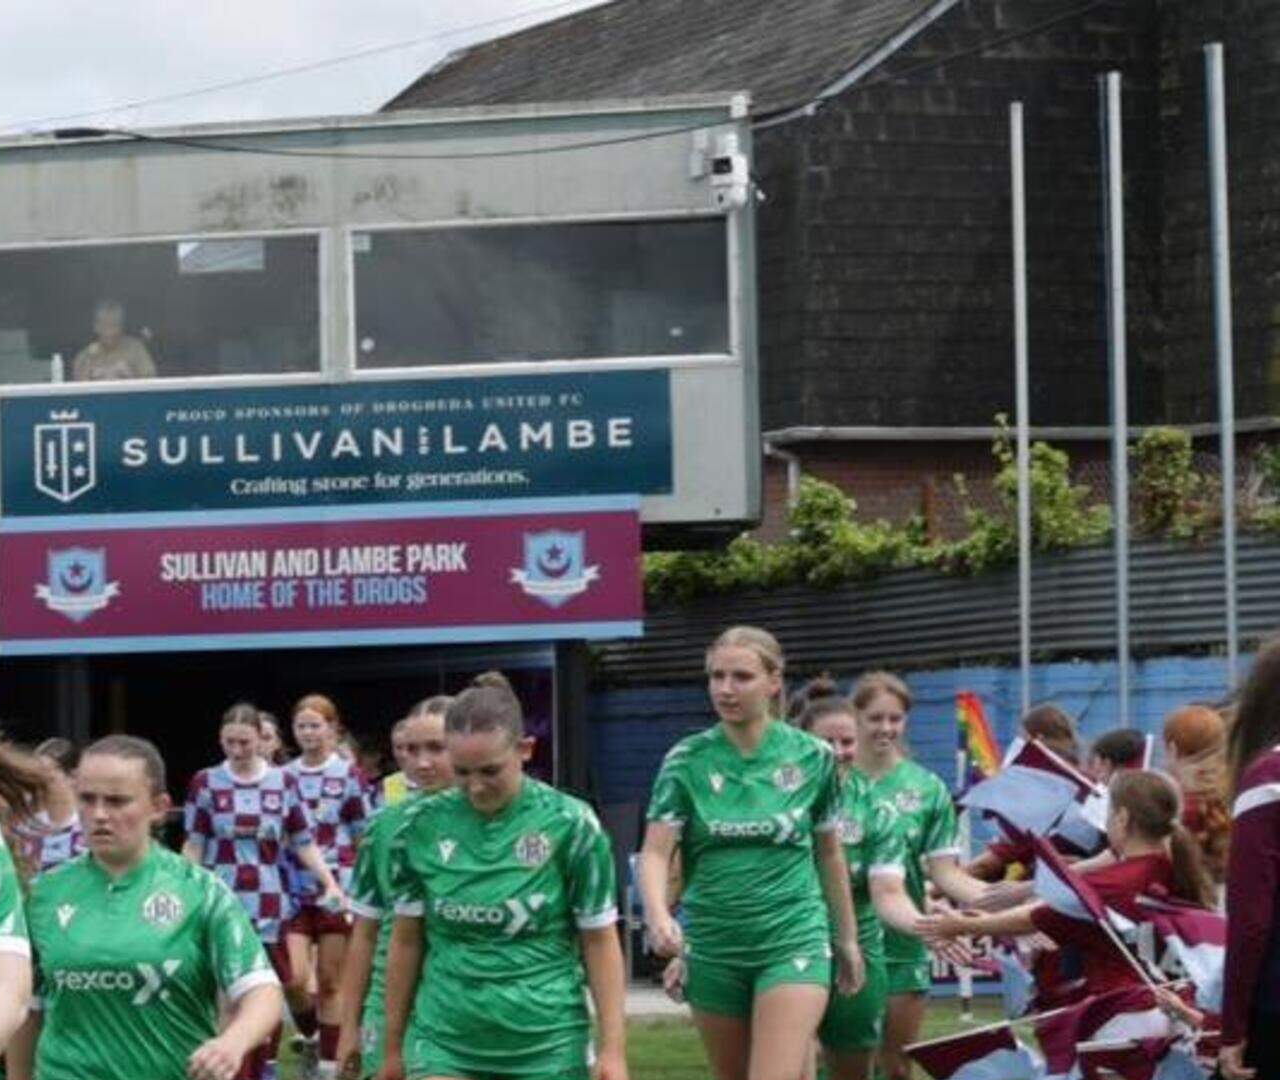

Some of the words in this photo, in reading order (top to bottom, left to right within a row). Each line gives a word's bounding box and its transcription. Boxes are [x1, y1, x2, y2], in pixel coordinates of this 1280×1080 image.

[340, 402, 366, 415] OF
[122, 426, 405, 467] SULLIVAN
[443, 417, 635, 455] LAMBE
[230, 476, 308, 497] Crafting
[312, 474, 369, 493] stone
[374, 470, 402, 489] for
[161, 550, 268, 582] SULLIVAN
[272, 547, 320, 578] AND
[323, 545, 403, 576] LAMBE
[406, 542, 468, 573] PARK
[201, 580, 265, 610] HOME
[271, 579, 300, 608] OF
[306, 577, 349, 607] THE
[353, 574, 428, 605] DROGS
